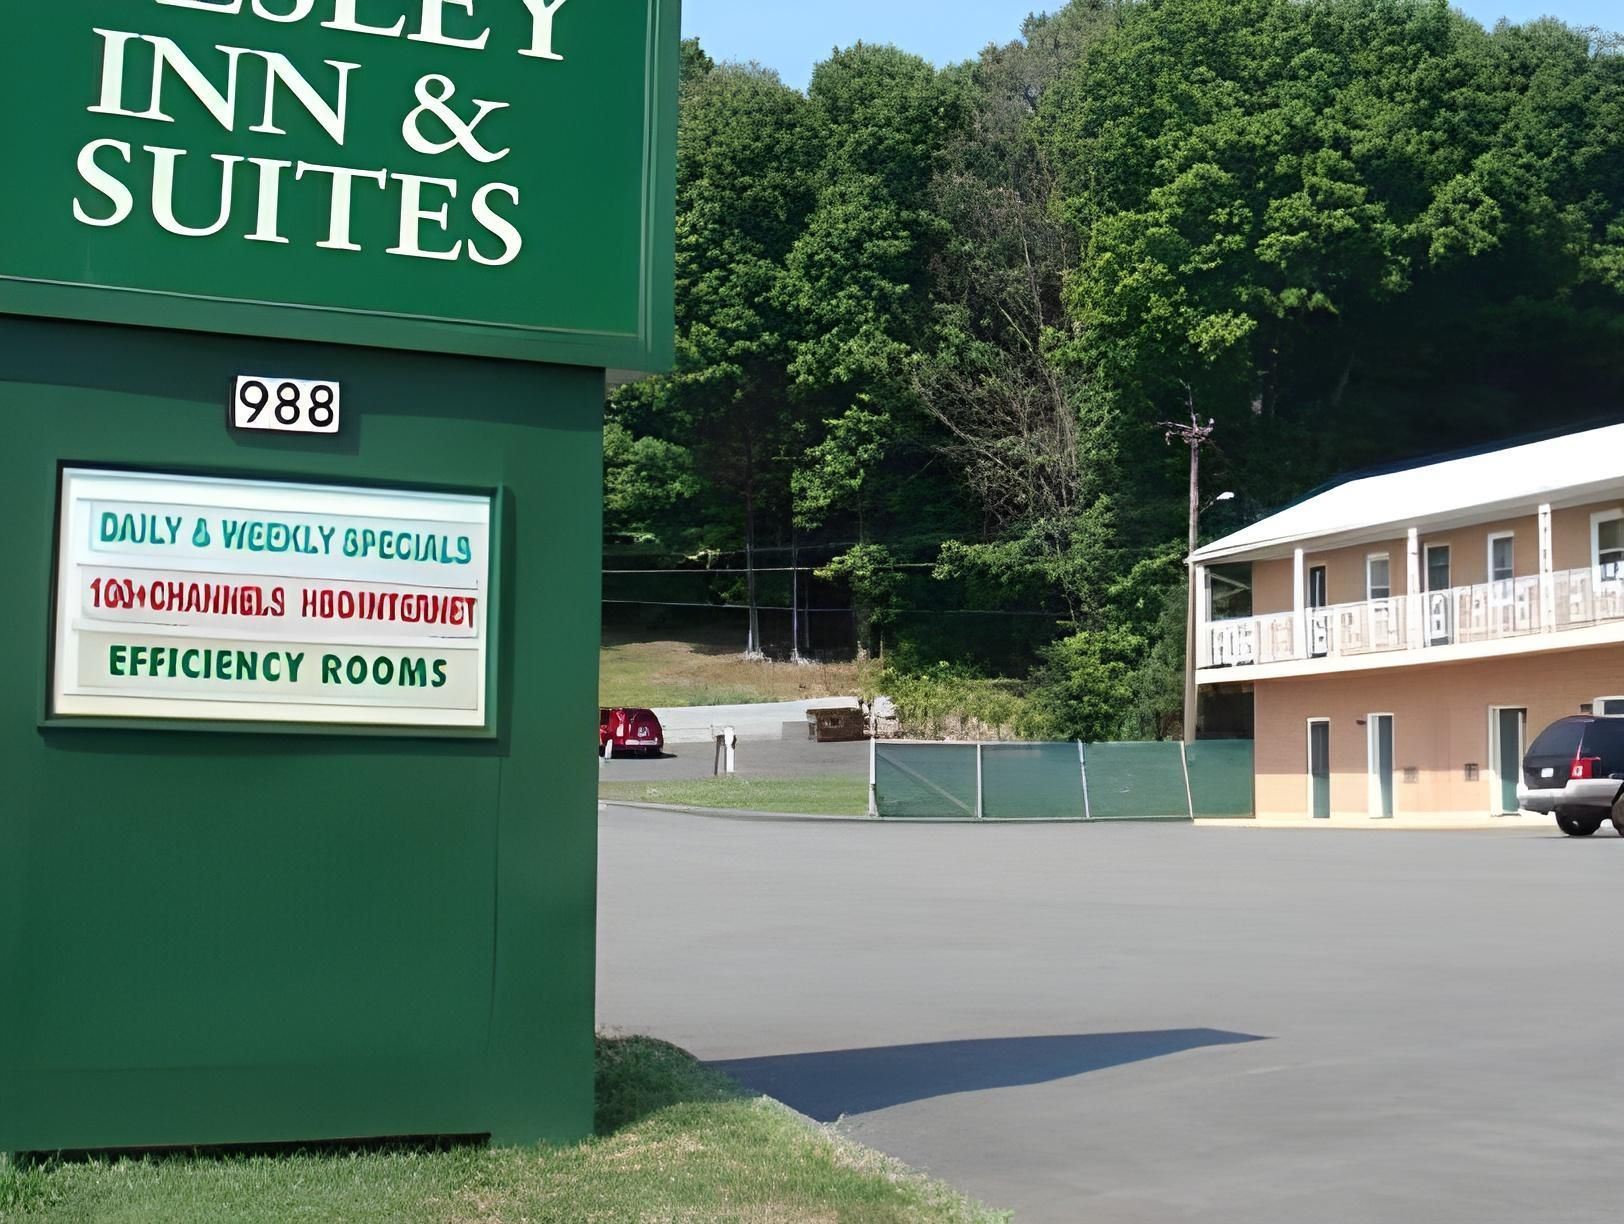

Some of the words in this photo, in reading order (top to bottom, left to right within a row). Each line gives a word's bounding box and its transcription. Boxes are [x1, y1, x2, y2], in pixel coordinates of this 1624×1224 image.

[87, 27, 362, 146] INN
[401, 73, 511, 164] &
[72, 138, 523, 267] SUITES
[239, 380, 335, 428] 988
[100, 511, 183, 545] DAILY
[342, 527, 472, 565] SPECIALS
[109, 644, 305, 683] EFFICIENCY
[321, 653, 448, 688] ROOMS
